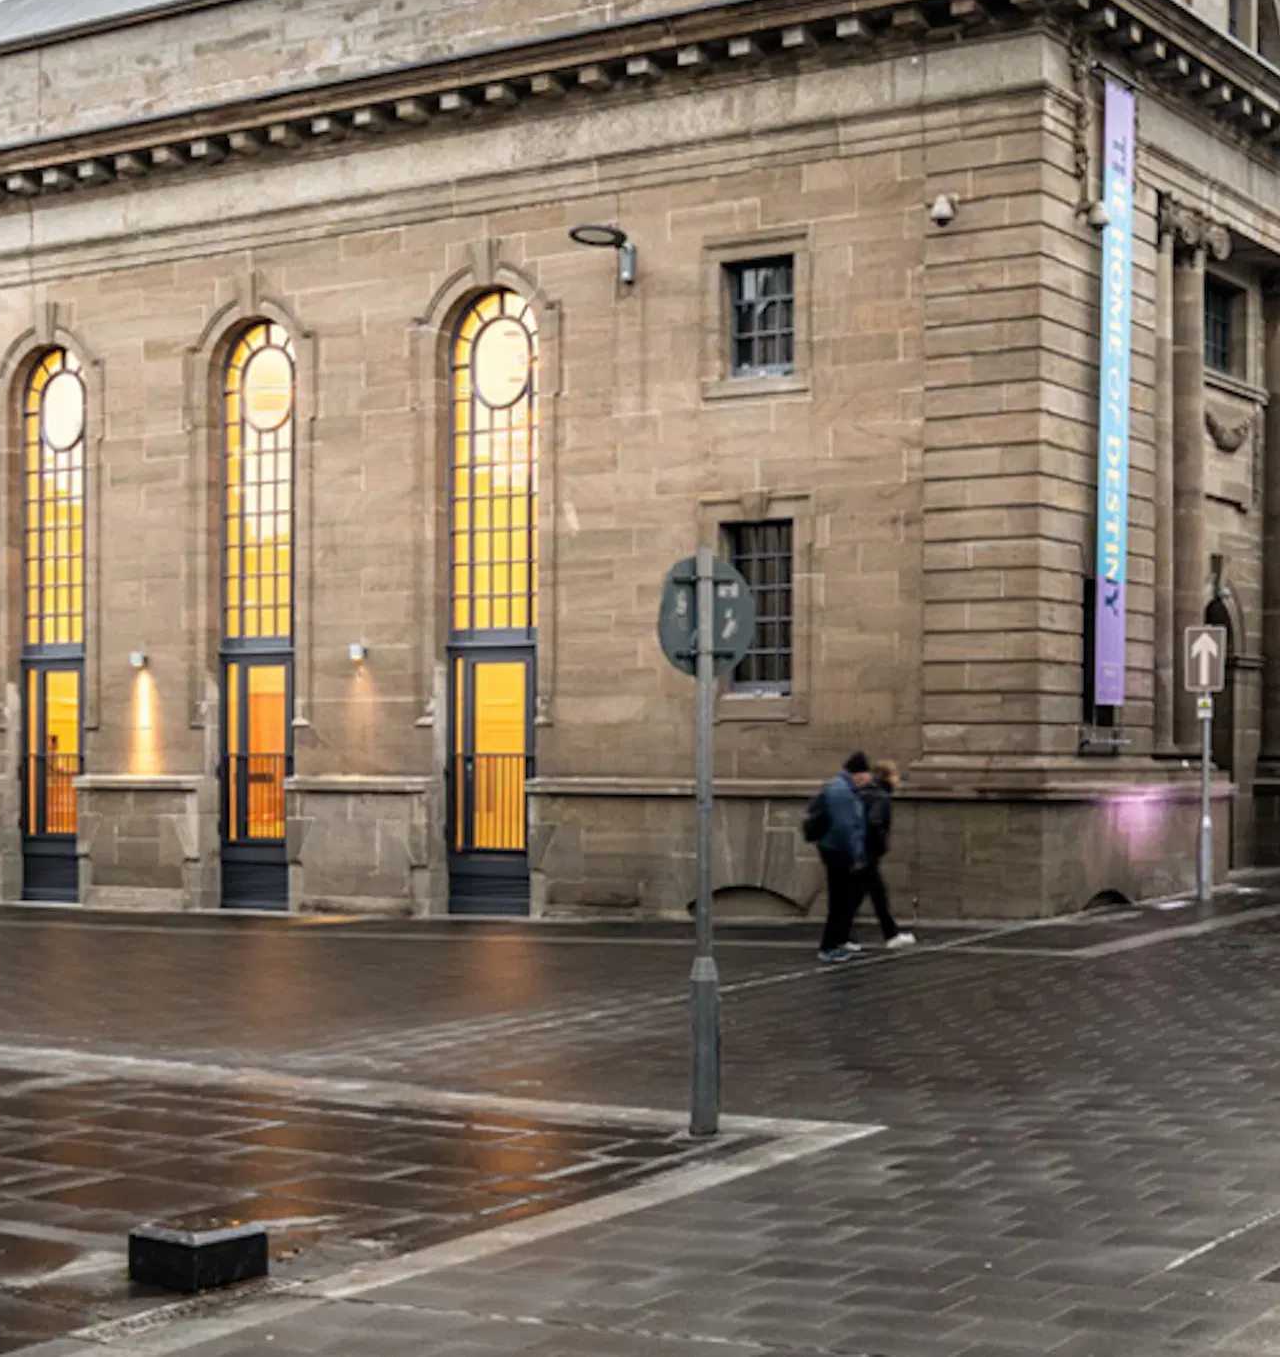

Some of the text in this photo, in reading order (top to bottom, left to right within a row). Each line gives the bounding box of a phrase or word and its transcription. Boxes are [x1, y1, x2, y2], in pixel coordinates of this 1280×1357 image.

[1103, 136, 1127, 617] THE HOME OF DESTINY
